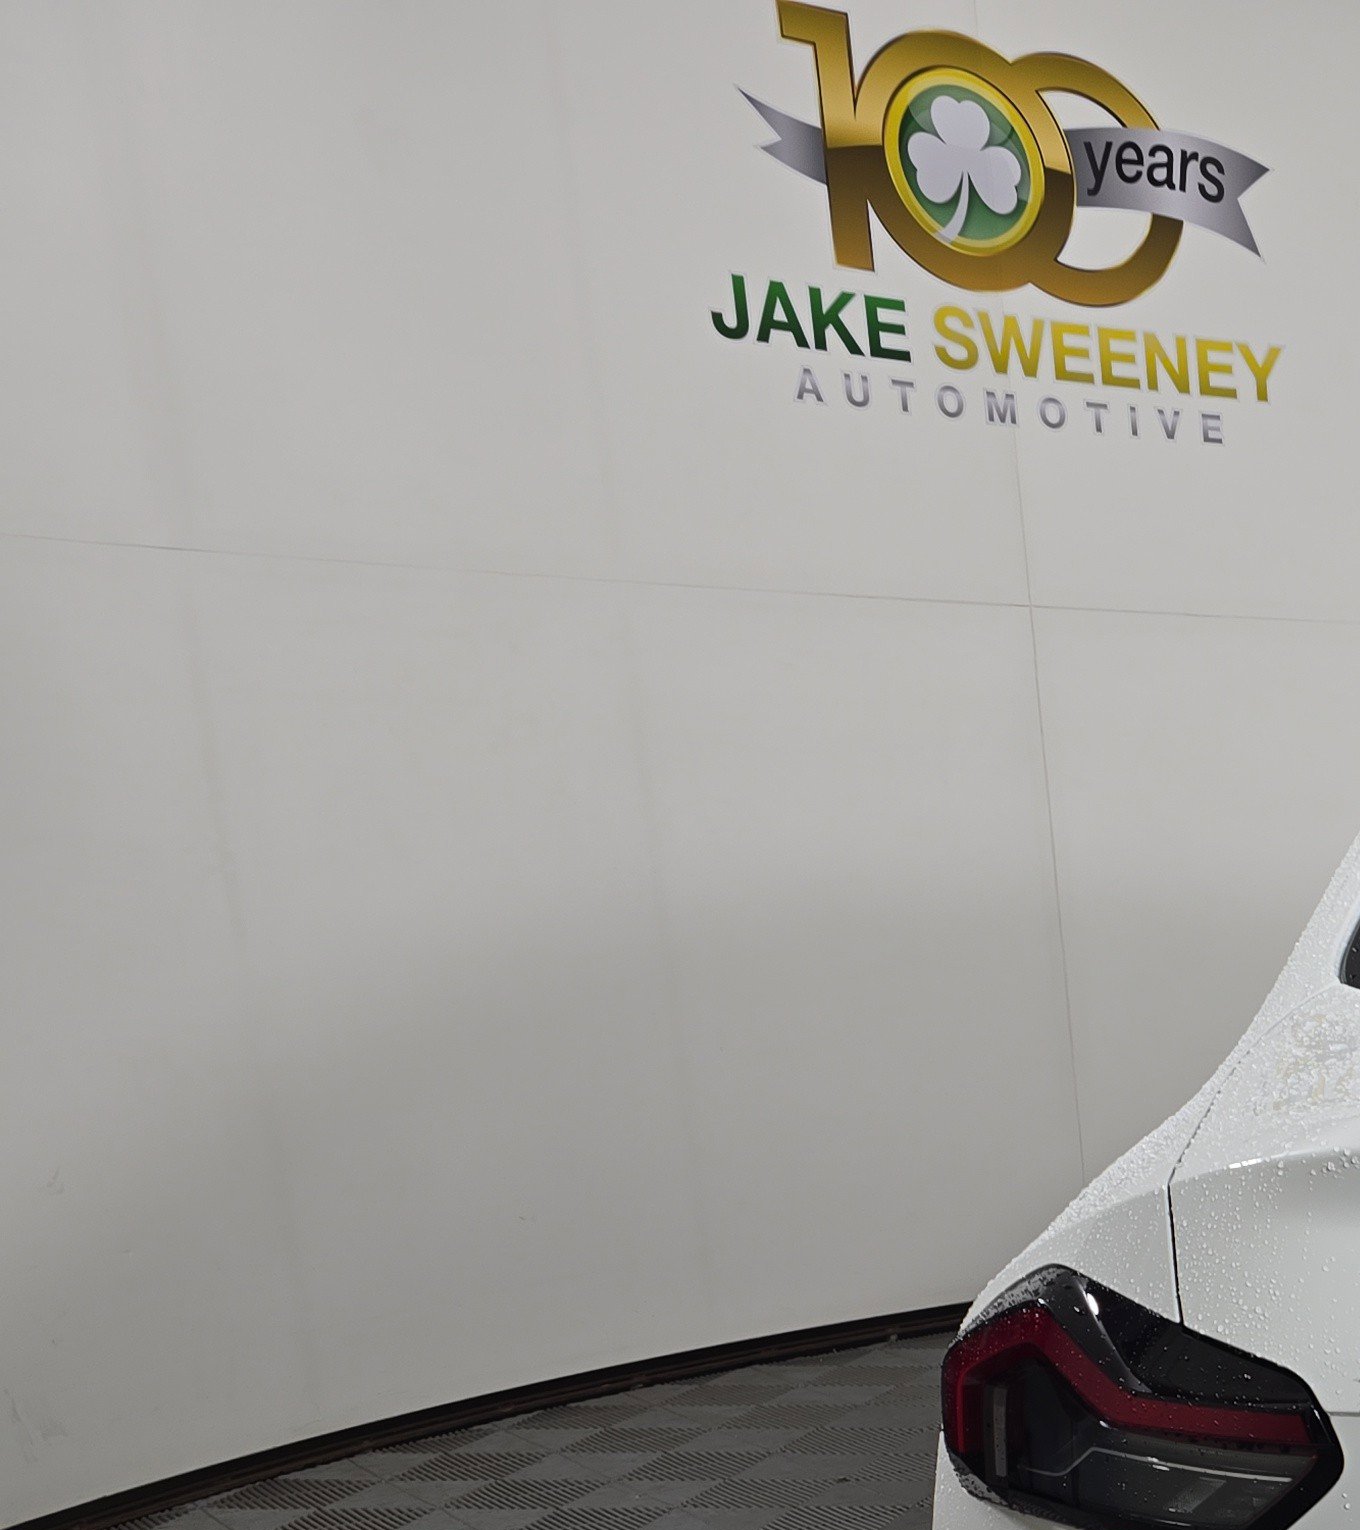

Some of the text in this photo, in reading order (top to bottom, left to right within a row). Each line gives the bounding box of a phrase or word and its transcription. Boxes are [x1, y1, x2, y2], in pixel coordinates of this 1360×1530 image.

[776, 0, 1226, 308] 100 years
[710, 273, 1282, 403] JAKE SWEENEY
[796, 367, 1224, 444] AUTOMOTIVE
